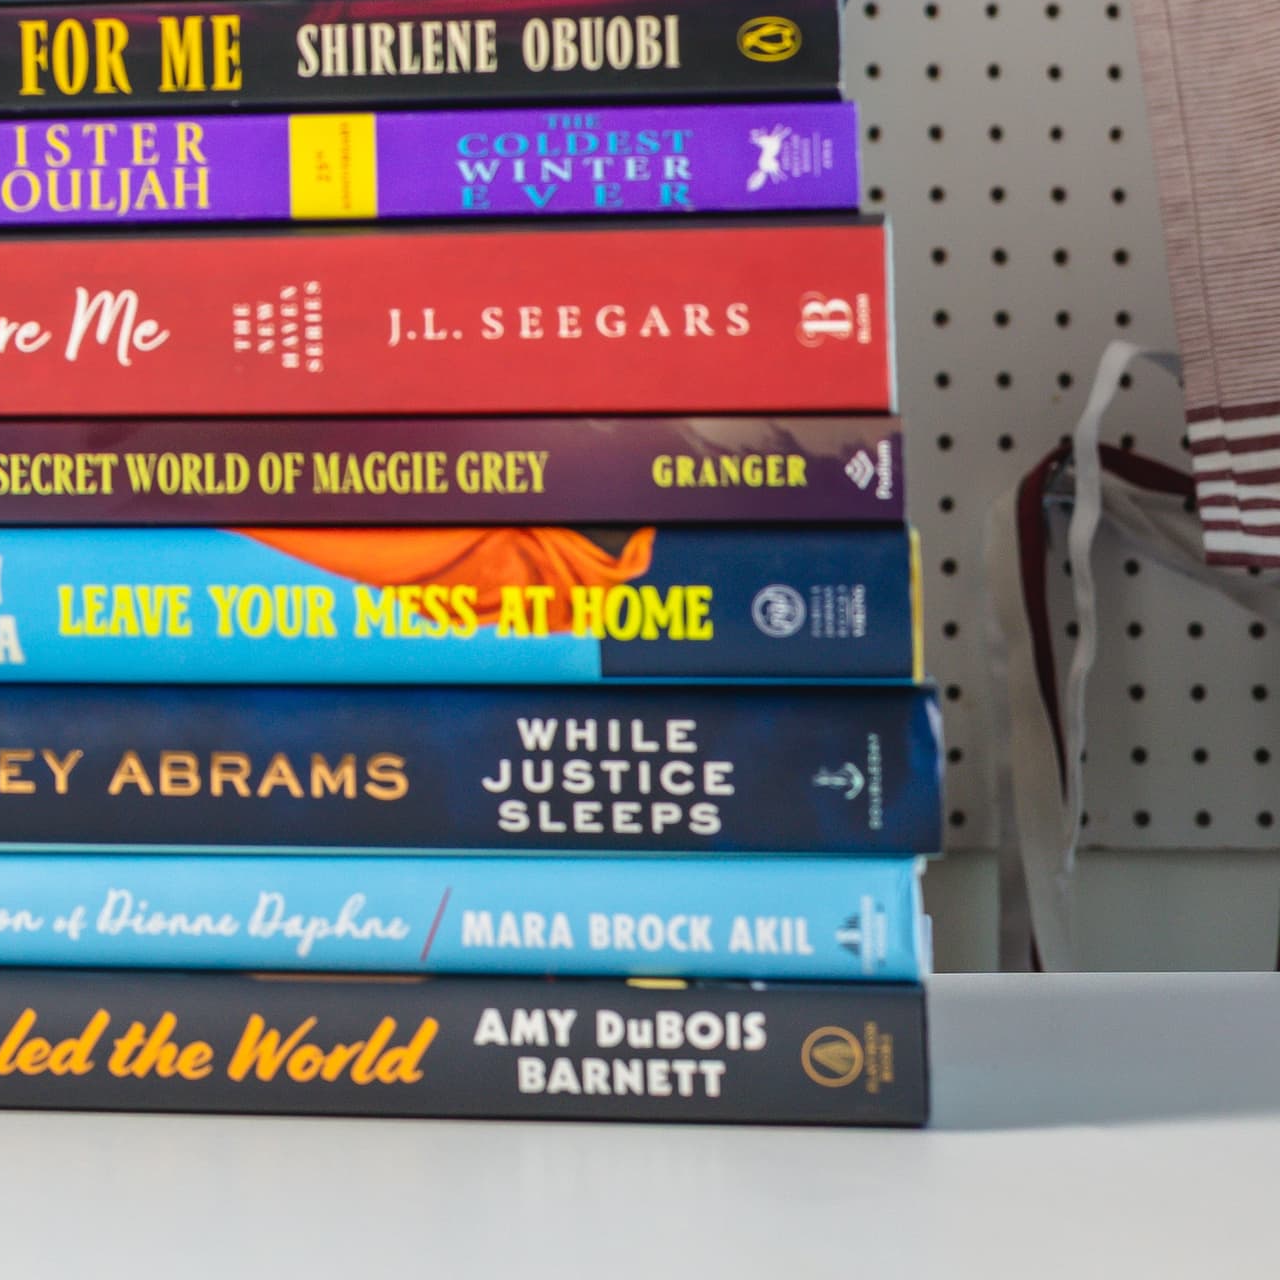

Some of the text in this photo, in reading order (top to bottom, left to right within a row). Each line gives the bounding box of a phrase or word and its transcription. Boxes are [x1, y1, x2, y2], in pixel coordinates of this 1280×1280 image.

[18, 17, 132, 96] FOR
[158, 14, 243, 93] ME
[296, 15, 681, 79] SHIRLENE OBUOBI
[455, 129, 694, 158] COLDEST
[545, 113, 601, 130] THE
[454, 156, 694, 184] WINTER
[460, 182, 694, 209] EVER
[64, 286, 171, 367] Me
[232, 303, 252, 353] THE
[256, 302, 275, 355] NEW
[280, 285, 300, 368] HAVEN
[303, 280, 324, 373] SERIES
[387, 302, 751, 347] J.L. SEEGARS
[124, 452, 250, 495] WORLD
[259, 452, 305, 494] OF
[313, 451, 449, 495] MAGGIE
[455, 450, 550, 495] GREY
[651, 454, 808, 488] GRANGER
[875, 440, 893, 500] Podium
[57, 584, 192, 637] LEAVE
[207, 584, 337, 638] YOUR
[352, 584, 478, 638] MESS
[495, 584, 556, 638] AT
[570, 584, 714, 641] HOME
[517, 718, 698, 753] WHILE
[107, 750, 411, 801] ABRAMS
[482, 759, 736, 797] JUSTICE
[498, 800, 722, 835] SLEEPS
[53, 906, 87, 940] of
[97, 888, 238, 938] Dionne
[247, 891, 411, 958] Daphne
[461, 910, 574, 949] MARA
[588, 913, 713, 953] BROCK
[729, 917, 814, 956] AKIL
[108, 1011, 214, 1081] the
[226, 1013, 440, 1085] World
[473, 1007, 768, 1051] AMY DuBOIS
[517, 1056, 727, 1098] BARNETT
